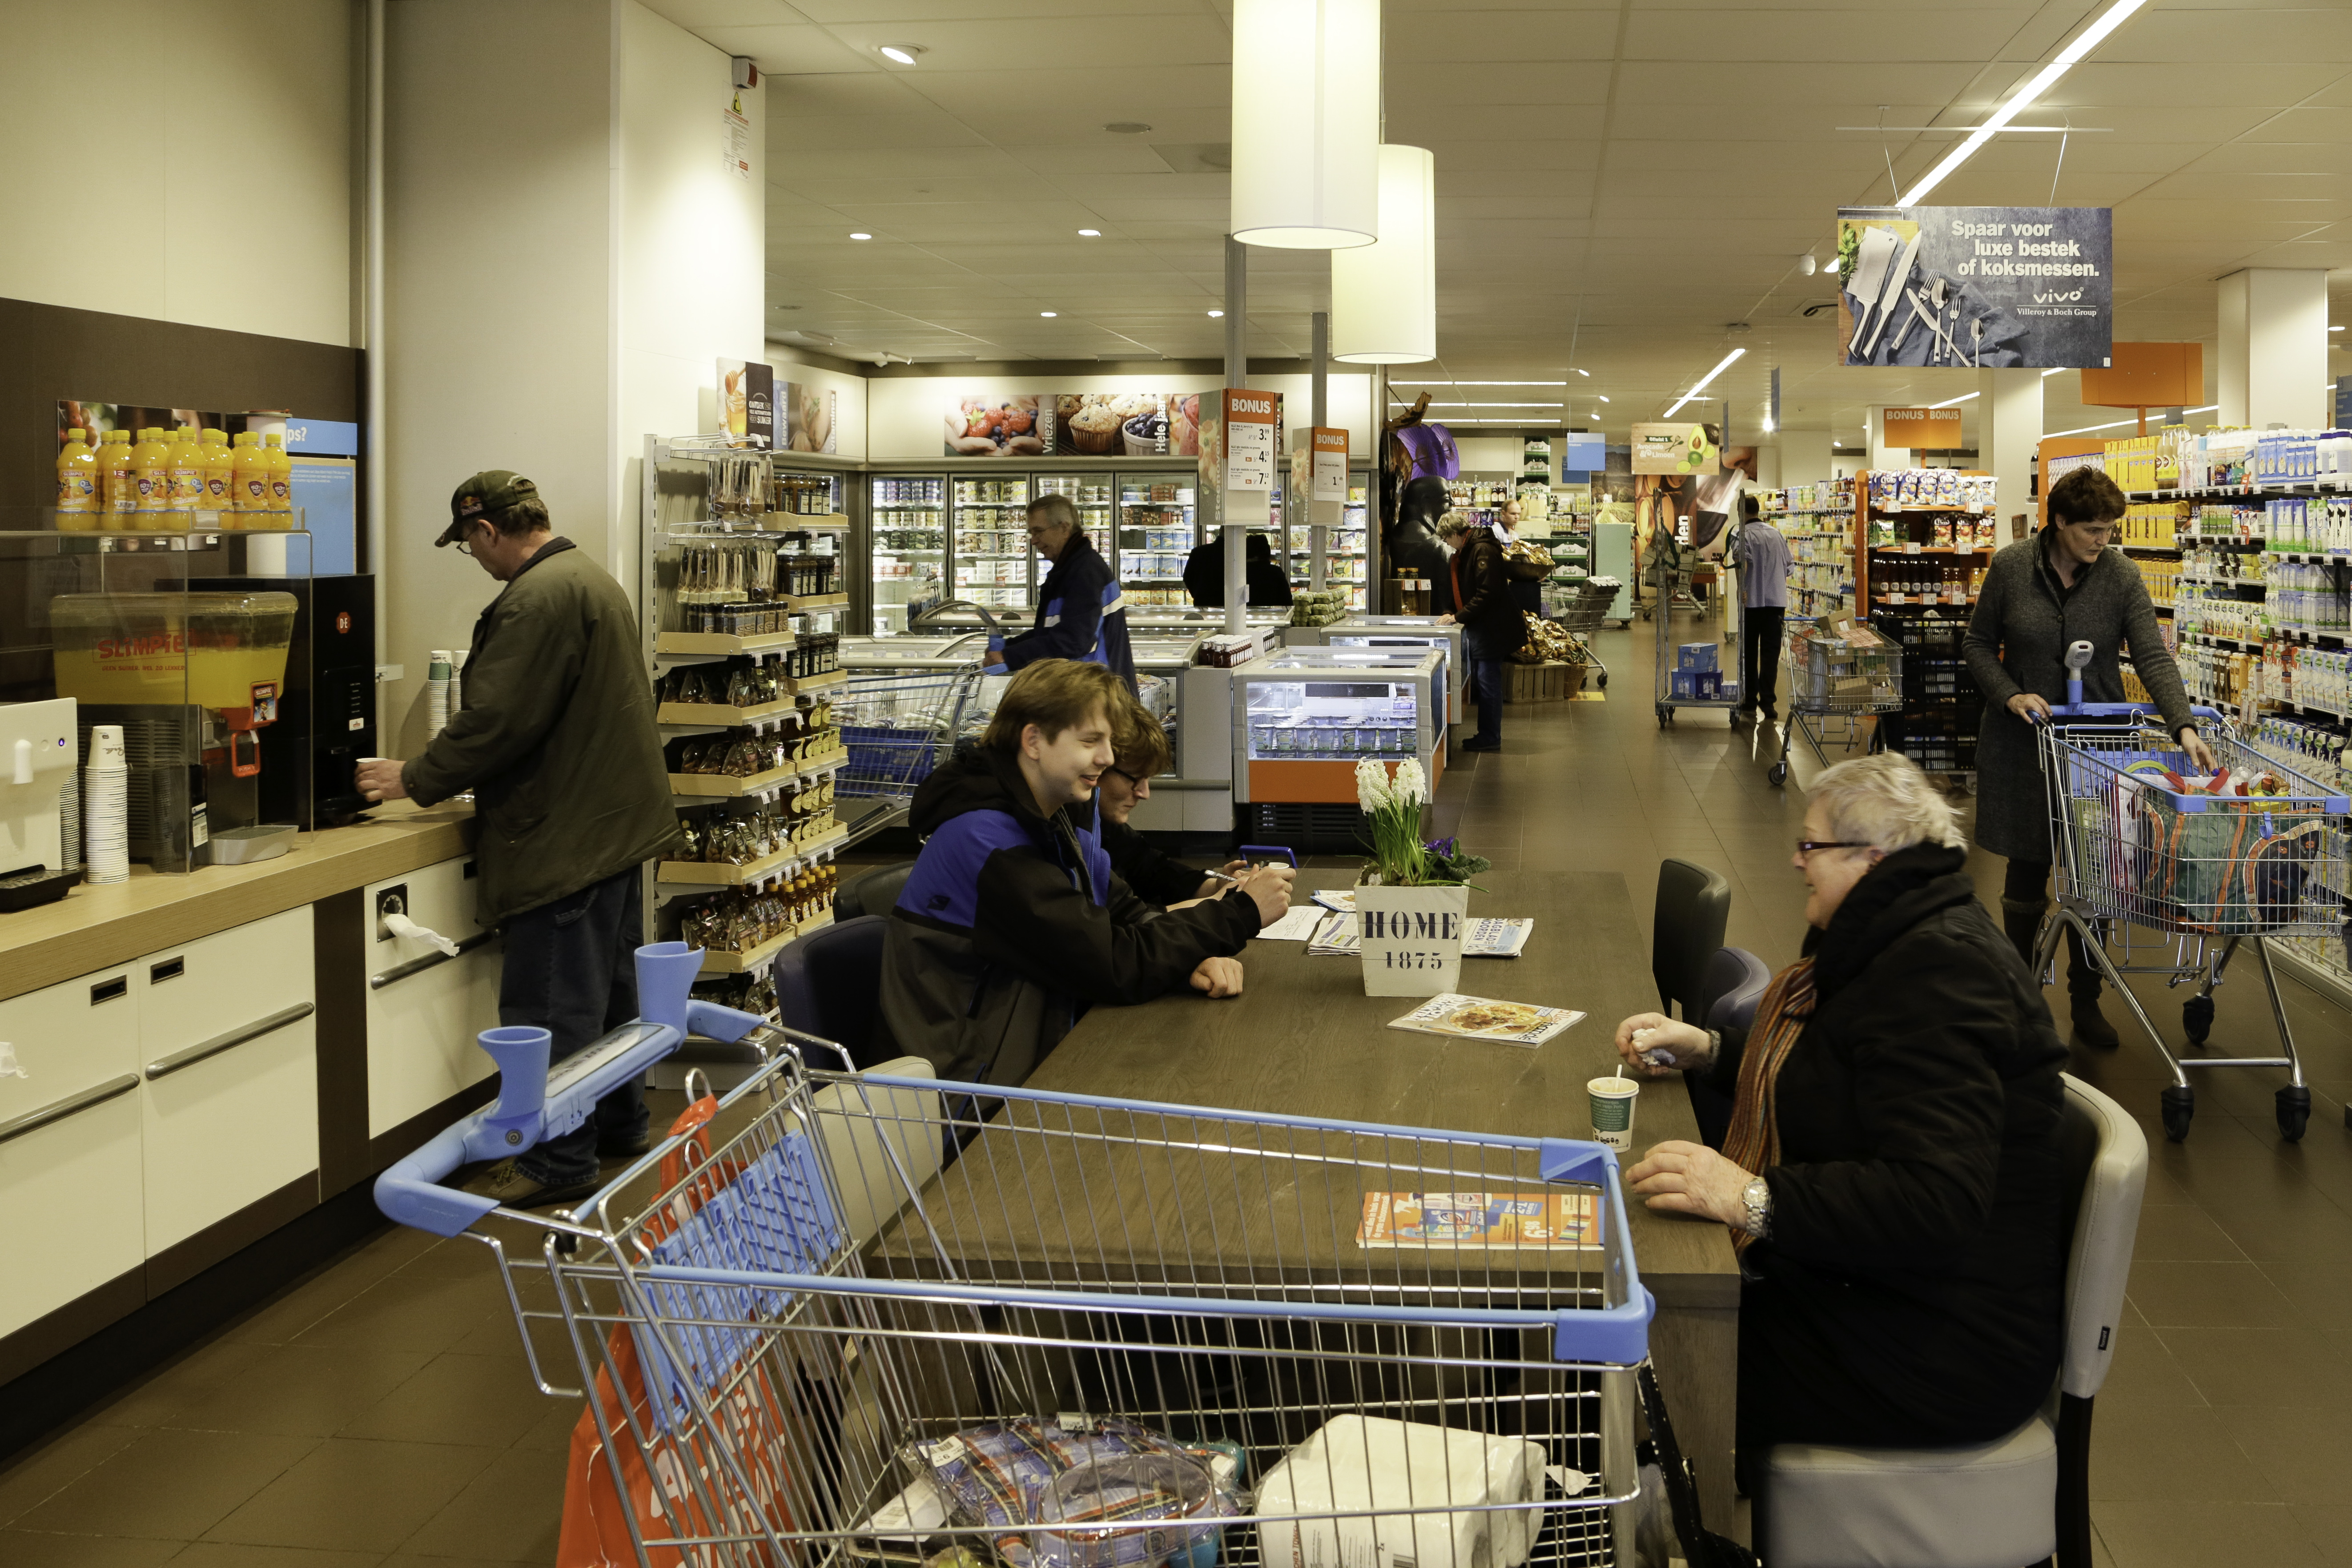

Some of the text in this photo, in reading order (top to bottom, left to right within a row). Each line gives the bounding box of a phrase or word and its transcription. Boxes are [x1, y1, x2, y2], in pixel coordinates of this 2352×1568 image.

[1951, 221, 2053, 239] Spaar voor
[1975, 240, 2081, 257] luxe bestek
[1958, 259, 2100, 276] of koksmessen.
[2017, 308, 2046, 317] Villeroy
[2054, 308, 2072, 316] Boch
[2074, 308, 2097, 317] Group
[1231, 398, 1271, 414] BONUS
[1886, 410, 1959, 420] BONUS BONUS
[1042, 408, 1053, 453] Vriezen
[1155, 400, 1168, 453] Hele jaar
[1316, 434, 1344, 446] BONUS
[1364, 910, 1458, 940] HOME
[1486, 918, 1504, 941] DAGBLAD
[1385, 951, 1443, 970] 1875
